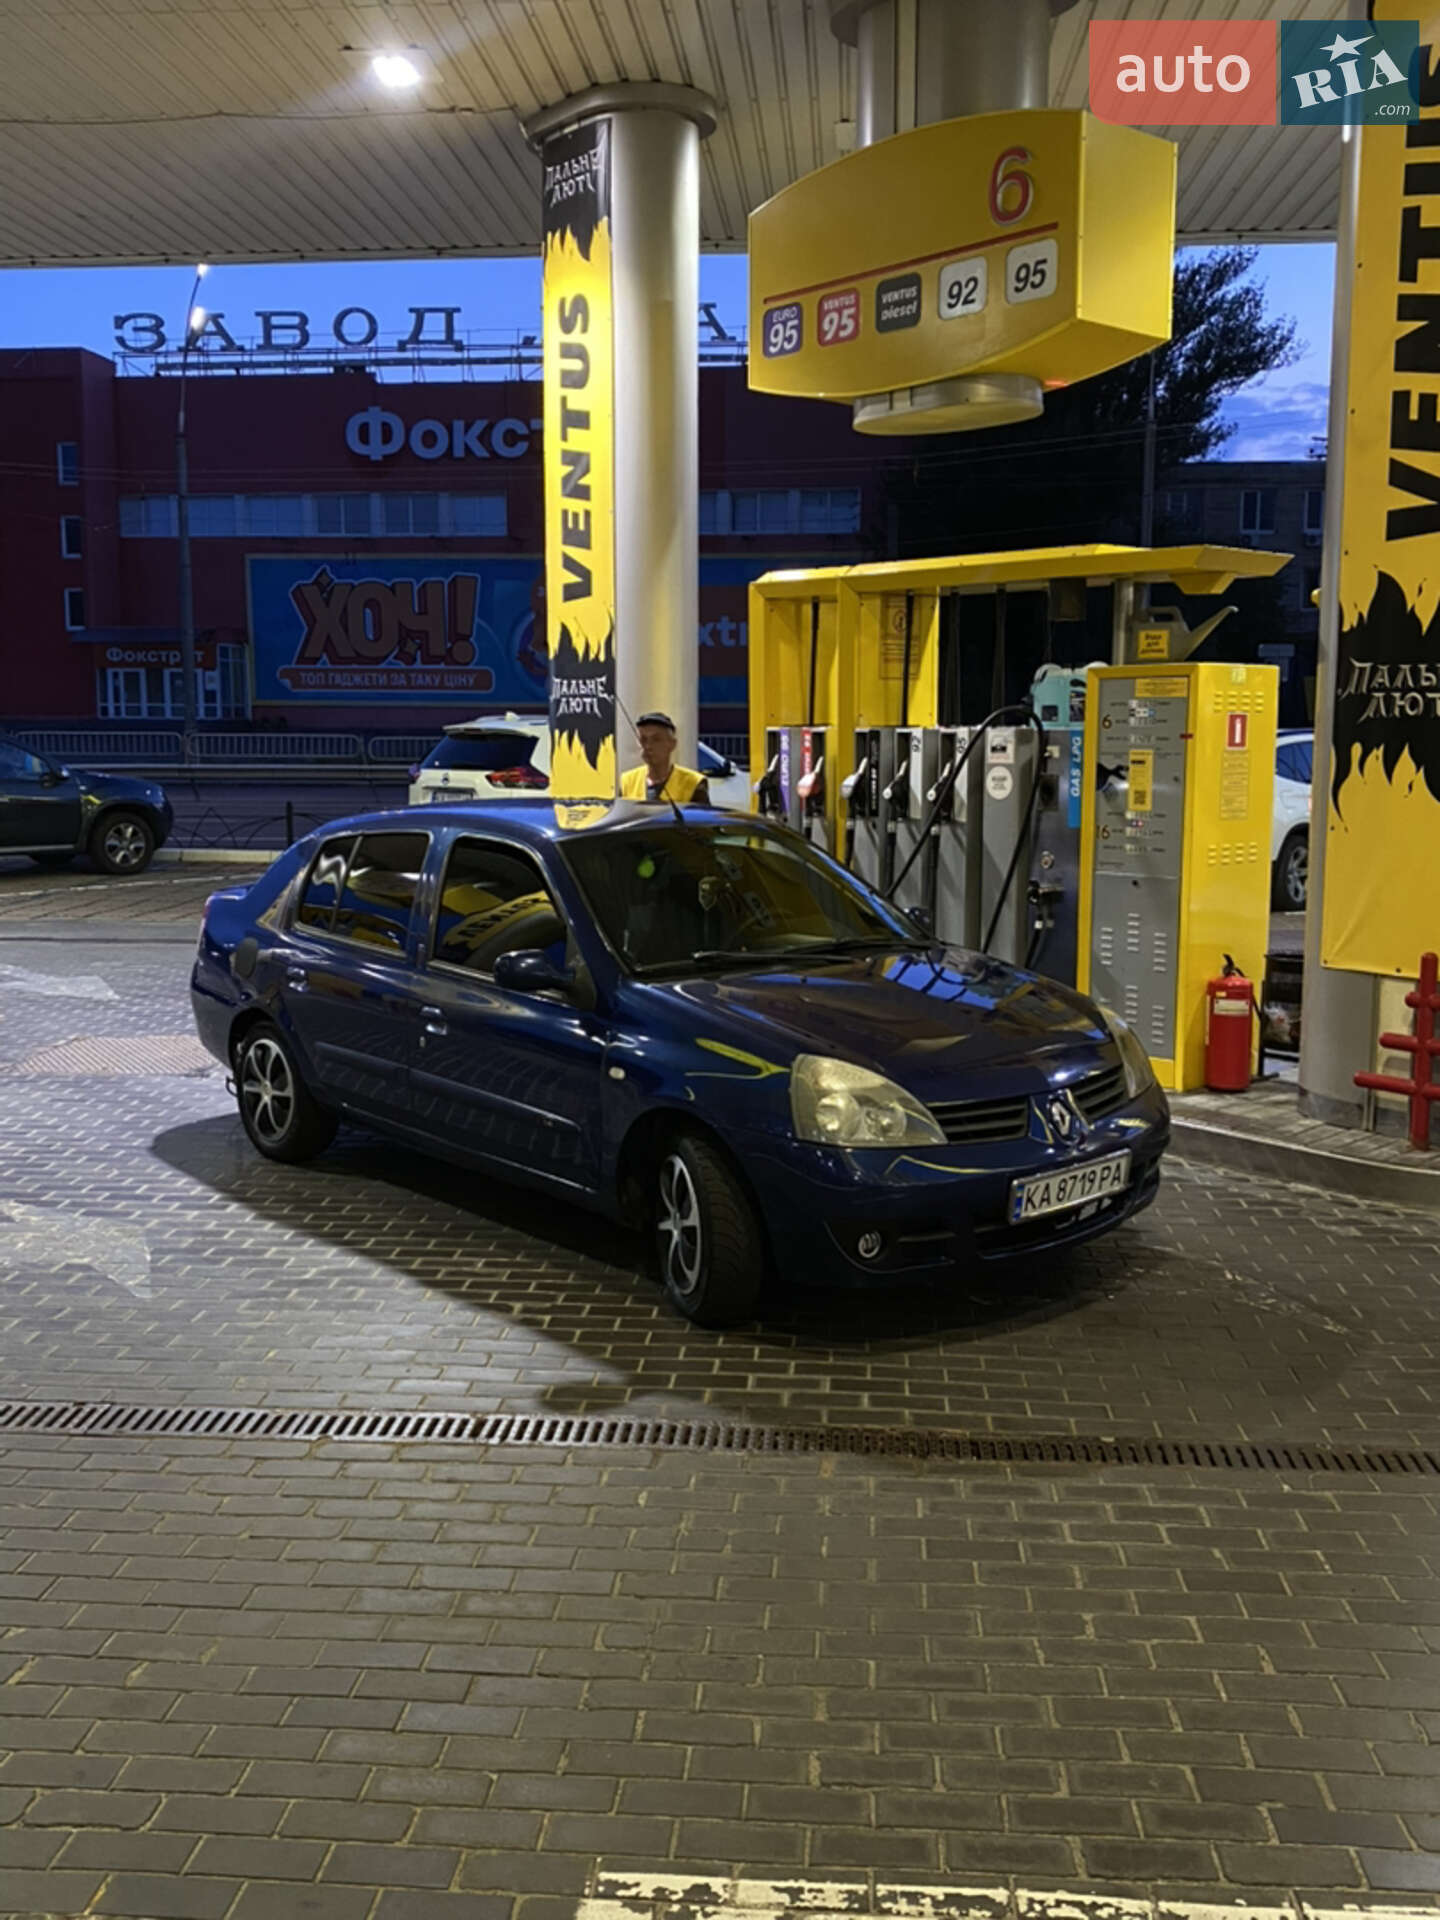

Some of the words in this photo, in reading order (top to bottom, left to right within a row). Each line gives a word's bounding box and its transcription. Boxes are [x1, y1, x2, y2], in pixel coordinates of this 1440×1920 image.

[988, 146, 1034, 226] 6
[946, 276, 980, 309] 92
[1013, 259, 1047, 293] 95
[823, 294, 856, 311] VENTUS
[881, 286, 918, 304] VENTUS
[113, 307, 463, 352] ЗАВОД
[772, 305, 798, 324] EURO
[823, 306, 857, 341] 95
[769, 320, 799, 354] 95
[558, 293, 593, 604] VENTUS
[292, 574, 479, 665] ХОЧ!
[105, 646, 205, 666] Фокстрт
[300, 672, 325, 686] ТОП
[390, 673, 406, 686] ЗА
[408, 673, 443, 687] ТАКУ
[550, 676, 614, 703] ПАЛЬНЕ
[1340, 656, 1440, 702] ПАЛЬ
[556, 697, 602, 718] ЛЮТІ
[1356, 691, 1440, 724] ЛЮТ
[911, 735, 921, 752] 92
[1072, 736, 1082, 762] LPG
[780, 753, 789, 786] EURO
[1071, 769, 1081, 797] GAS
[1024, 1182, 1051, 1211] KA
[1057, 1170, 1097, 1202] 8719
[1099, 1163, 1121, 1191] PA
